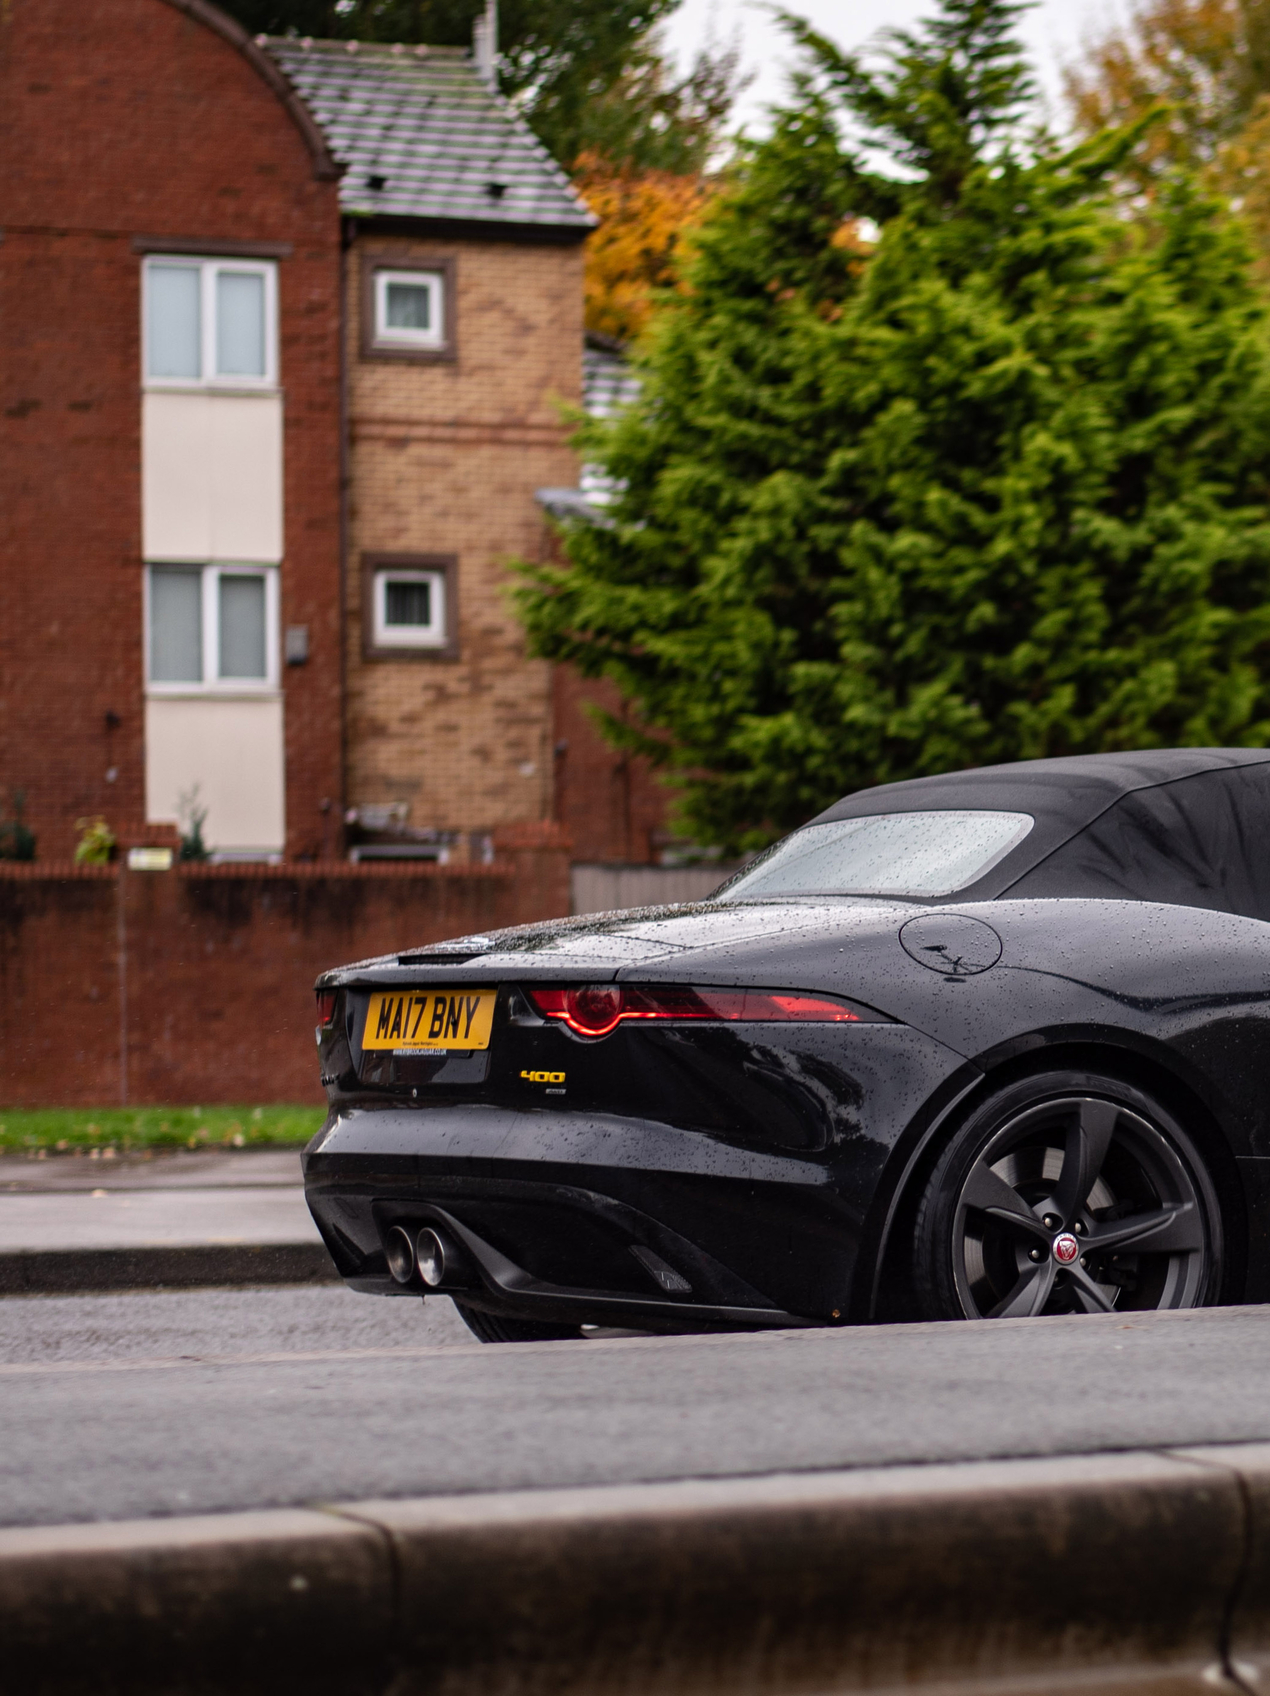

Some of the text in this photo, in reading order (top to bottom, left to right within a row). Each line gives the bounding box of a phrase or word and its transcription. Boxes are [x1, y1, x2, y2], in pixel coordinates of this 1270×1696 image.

[375, 996, 481, 1039] MA17 BNY
[520, 1070, 566, 1083] 400
